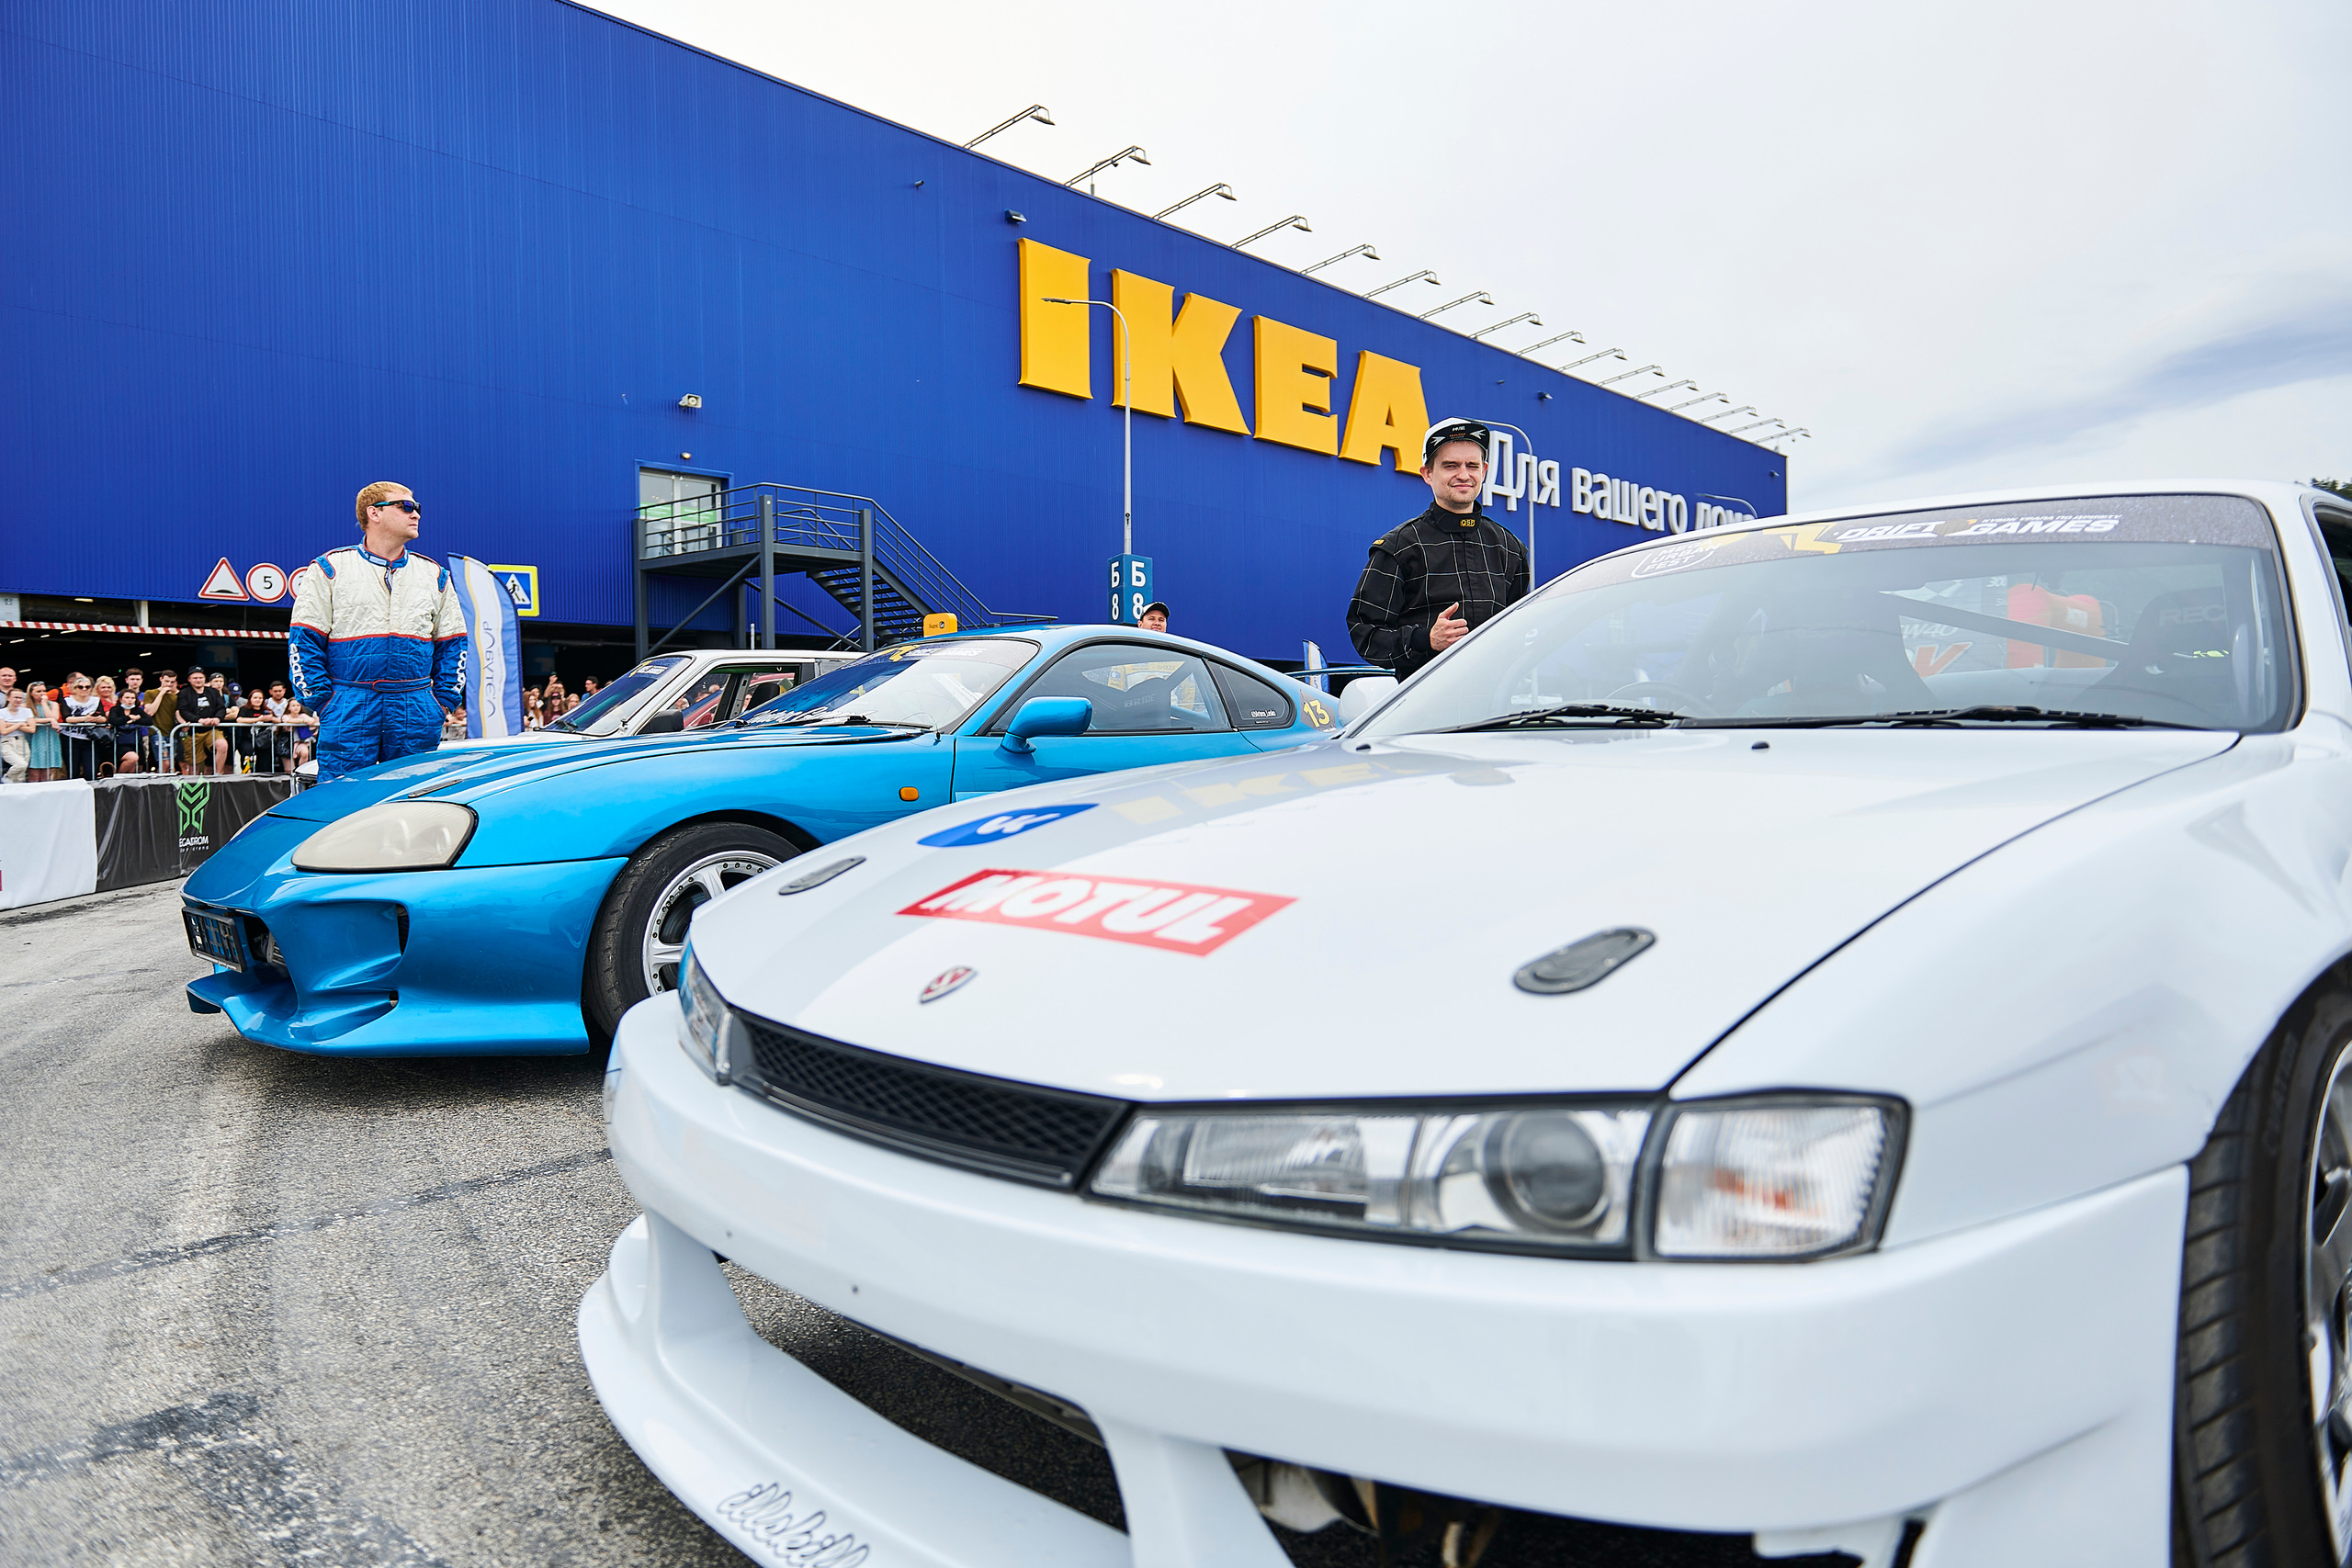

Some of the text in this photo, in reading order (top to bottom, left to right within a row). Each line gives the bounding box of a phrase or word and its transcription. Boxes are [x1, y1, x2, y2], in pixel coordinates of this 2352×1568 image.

[1017, 236, 1430, 476] IKEA
[1482, 430, 1560, 512] Для
[1571, 467, 1688, 535] вашего
[1836, 518, 2120, 540] DRIFT GAMES
[1111, 560, 1120, 588] Б
[1131, 560, 1147, 588] Б
[1643, 555, 1696, 572] FEST
[263, 575, 273, 590] 5
[1112, 592, 1119, 621] 8
[1132, 592, 1144, 621] 8
[1124, 694, 1156, 708] BRIDE
[1303, 699, 1330, 728] 13
[920, 874, 1257, 946] MOTUL
